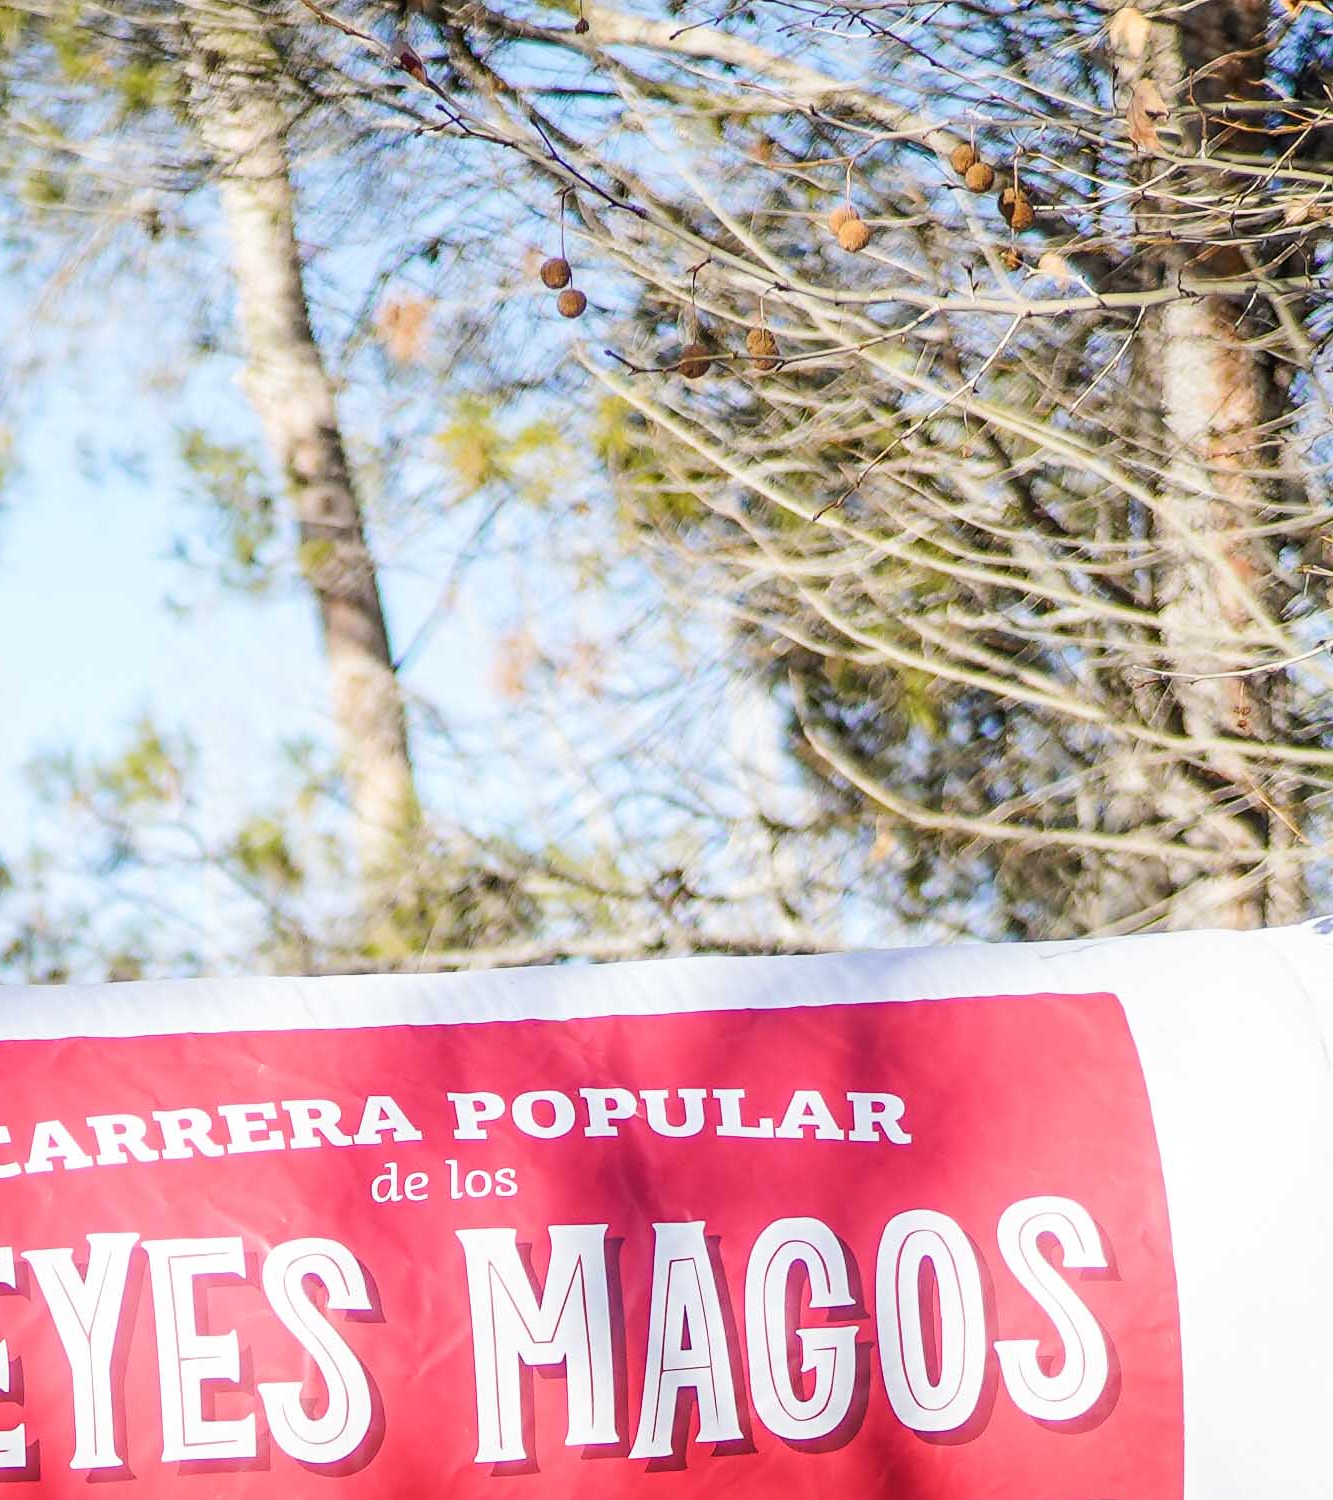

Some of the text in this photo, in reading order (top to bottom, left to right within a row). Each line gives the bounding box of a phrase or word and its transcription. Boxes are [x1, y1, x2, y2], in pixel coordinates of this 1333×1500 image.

[449, 1087, 913, 1146] POPULAR
[369, 1158, 520, 1204] de los
[455, 1195, 1118, 1470] MAGOS
